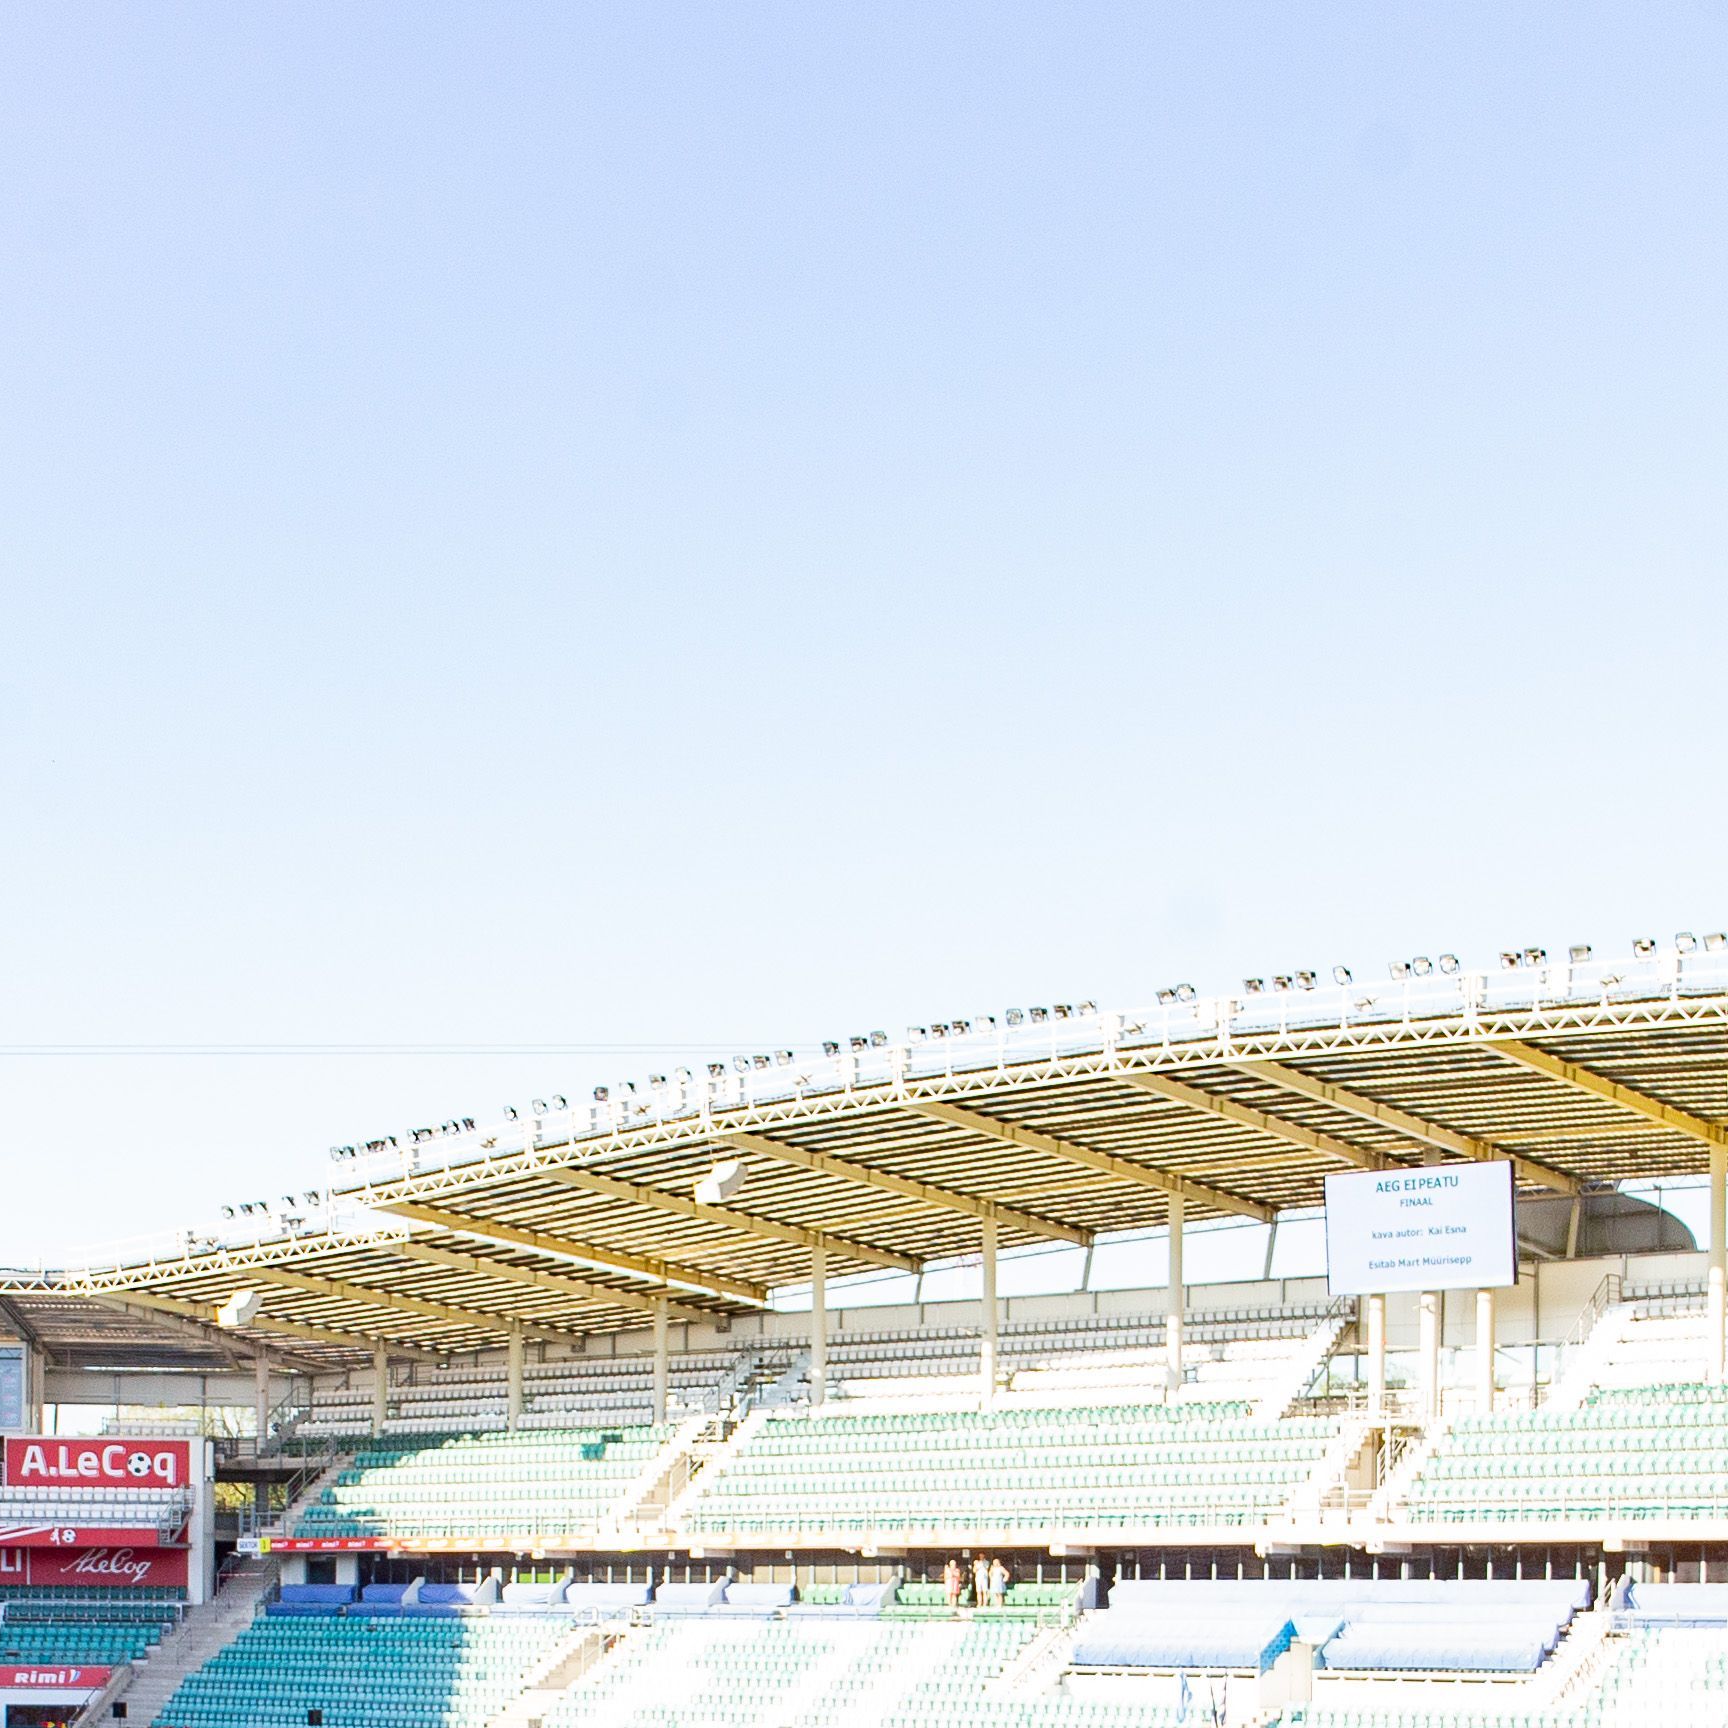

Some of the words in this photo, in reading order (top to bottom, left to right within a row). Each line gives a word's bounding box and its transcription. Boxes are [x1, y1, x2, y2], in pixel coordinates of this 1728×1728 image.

[1376, 1180, 1400, 1193] AEG
[1404, 1179, 1417, 1190] EI
[1419, 1176, 1459, 1189] PEATU
[1400, 1197, 1433, 1207] FINAAL
[1372, 1230, 1393, 1239] kava
[1396, 1228, 1424, 1238] autor:
[1428, 1226, 1443, 1236] Kai
[1445, 1225, 1467, 1234] Esna
[1369, 1259, 1396, 1269] Esitab
[1398, 1257, 1420, 1267] Mart
